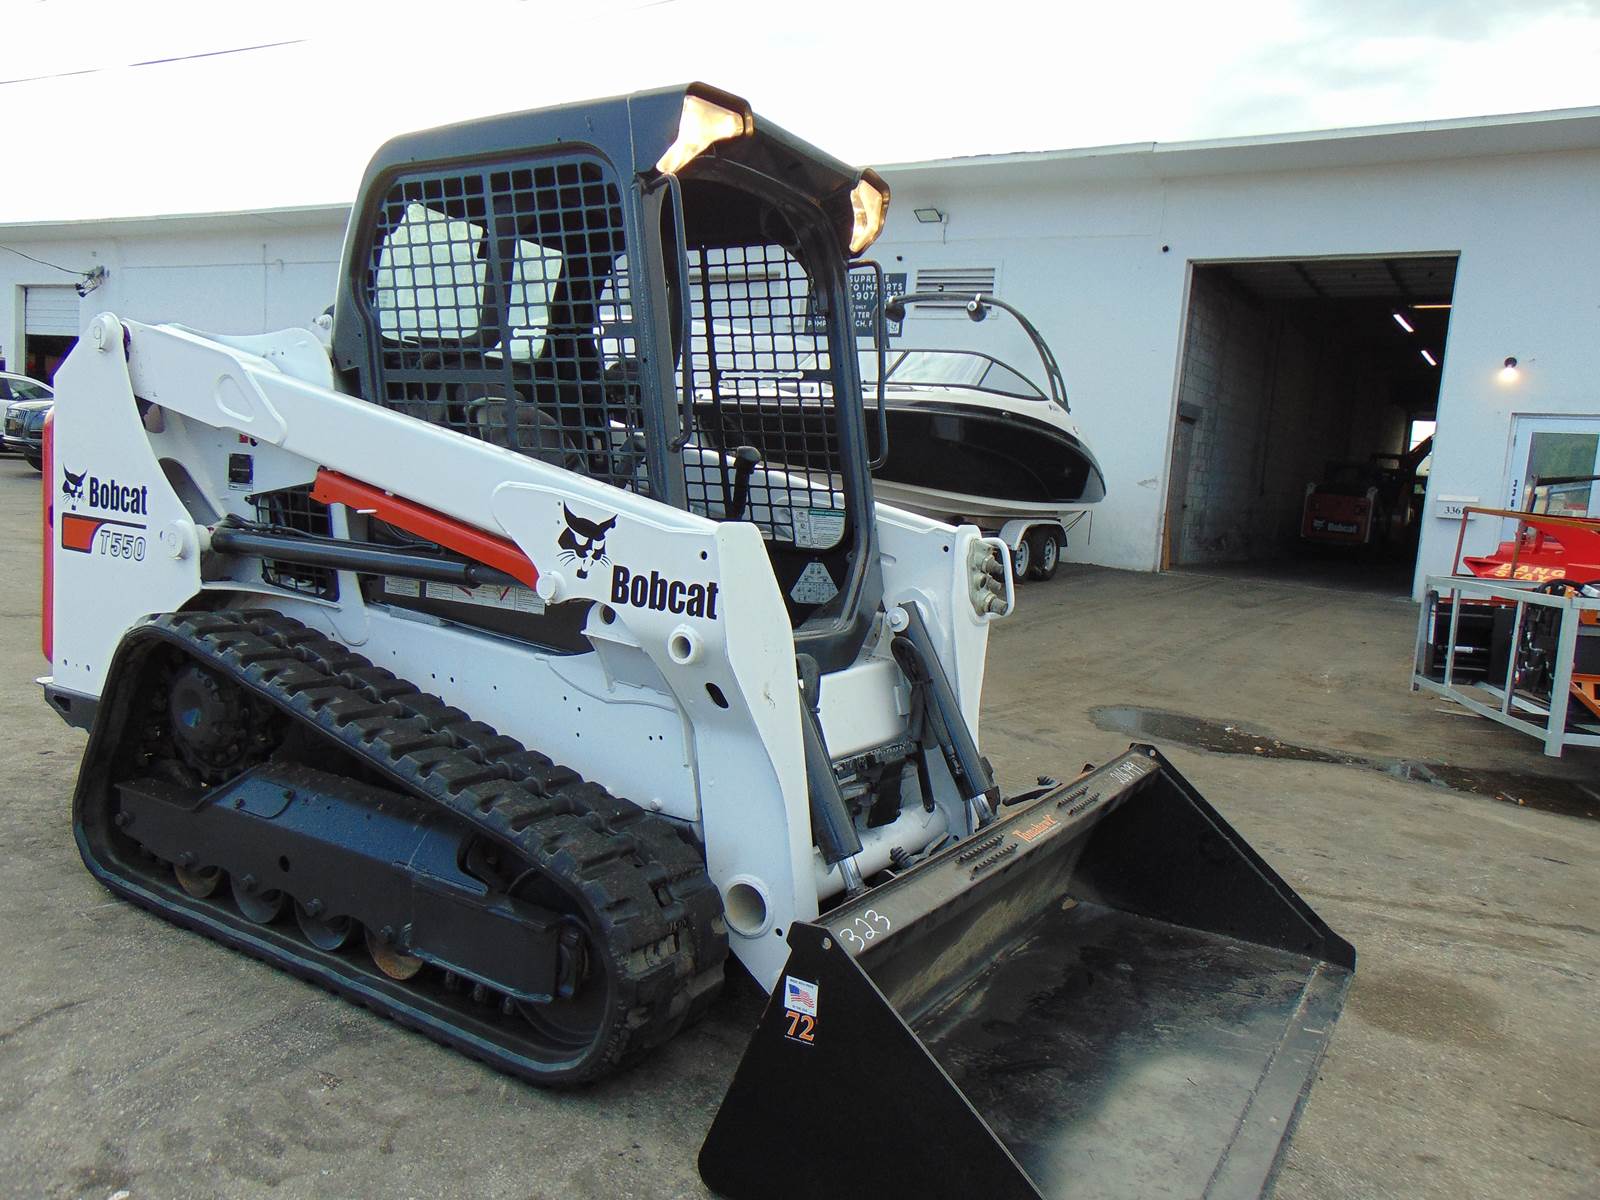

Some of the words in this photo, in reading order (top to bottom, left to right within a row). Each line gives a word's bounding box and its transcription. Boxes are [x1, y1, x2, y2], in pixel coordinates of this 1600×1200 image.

[89, 477, 148, 515] Bobcat
[100, 529, 147, 561] T550
[610, 565, 719, 620] Bobcat
[840, 909, 890, 952] 323
[785, 1010, 814, 1041] 72
